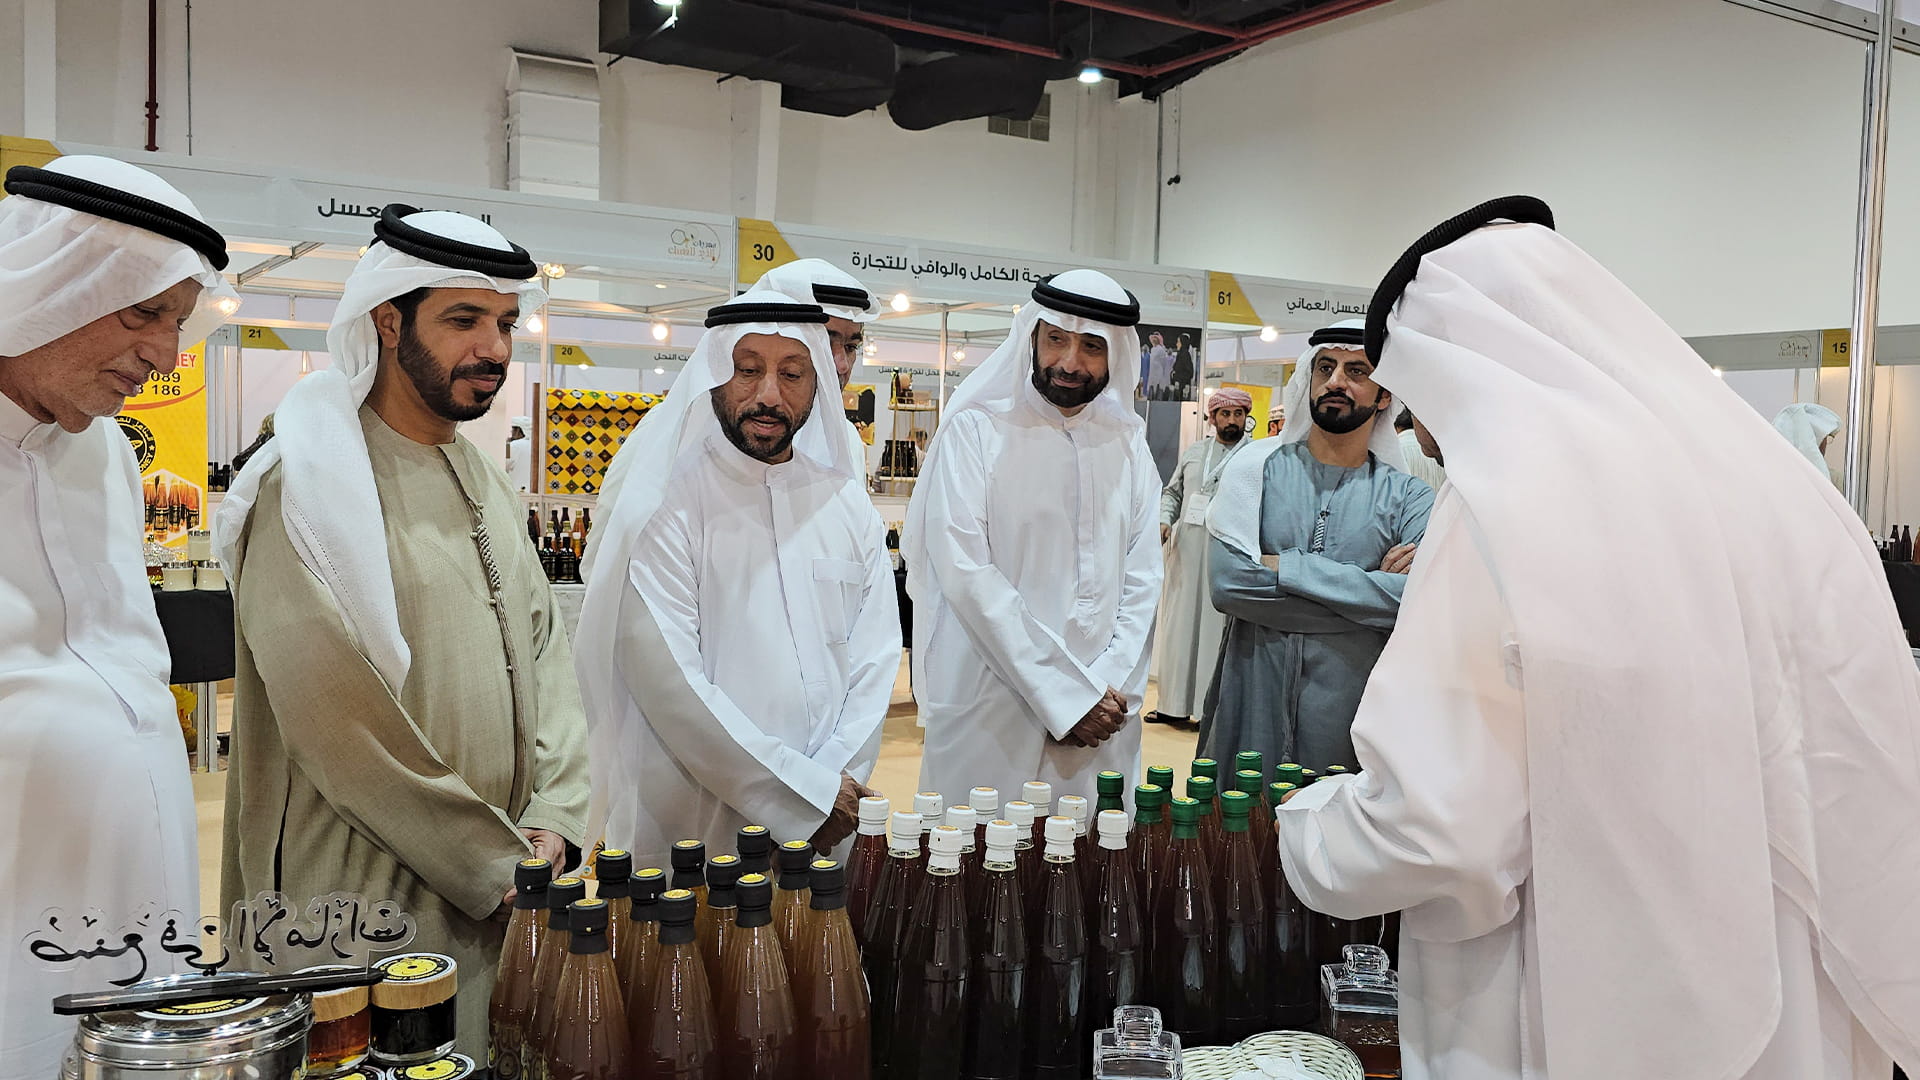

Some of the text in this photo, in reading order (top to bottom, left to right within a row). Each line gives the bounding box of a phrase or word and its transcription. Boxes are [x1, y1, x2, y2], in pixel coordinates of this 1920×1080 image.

[318, 198, 382, 218] عسل
[753, 243, 774, 262] 30
[851, 251, 907, 272] للتجارة
[911, 259, 967, 279] والوافي
[970, 265, 1019, 282] الكامل
[1217, 291, 1232, 306] 61
[1286, 297, 1330, 315] العماني
[248, 328, 261, 338] 21
[561, 347, 573, 356] 20
[1832, 342, 1847, 354] 15
[152, 384, 181, 396] 186
[139, 452, 154, 472] ONEY
